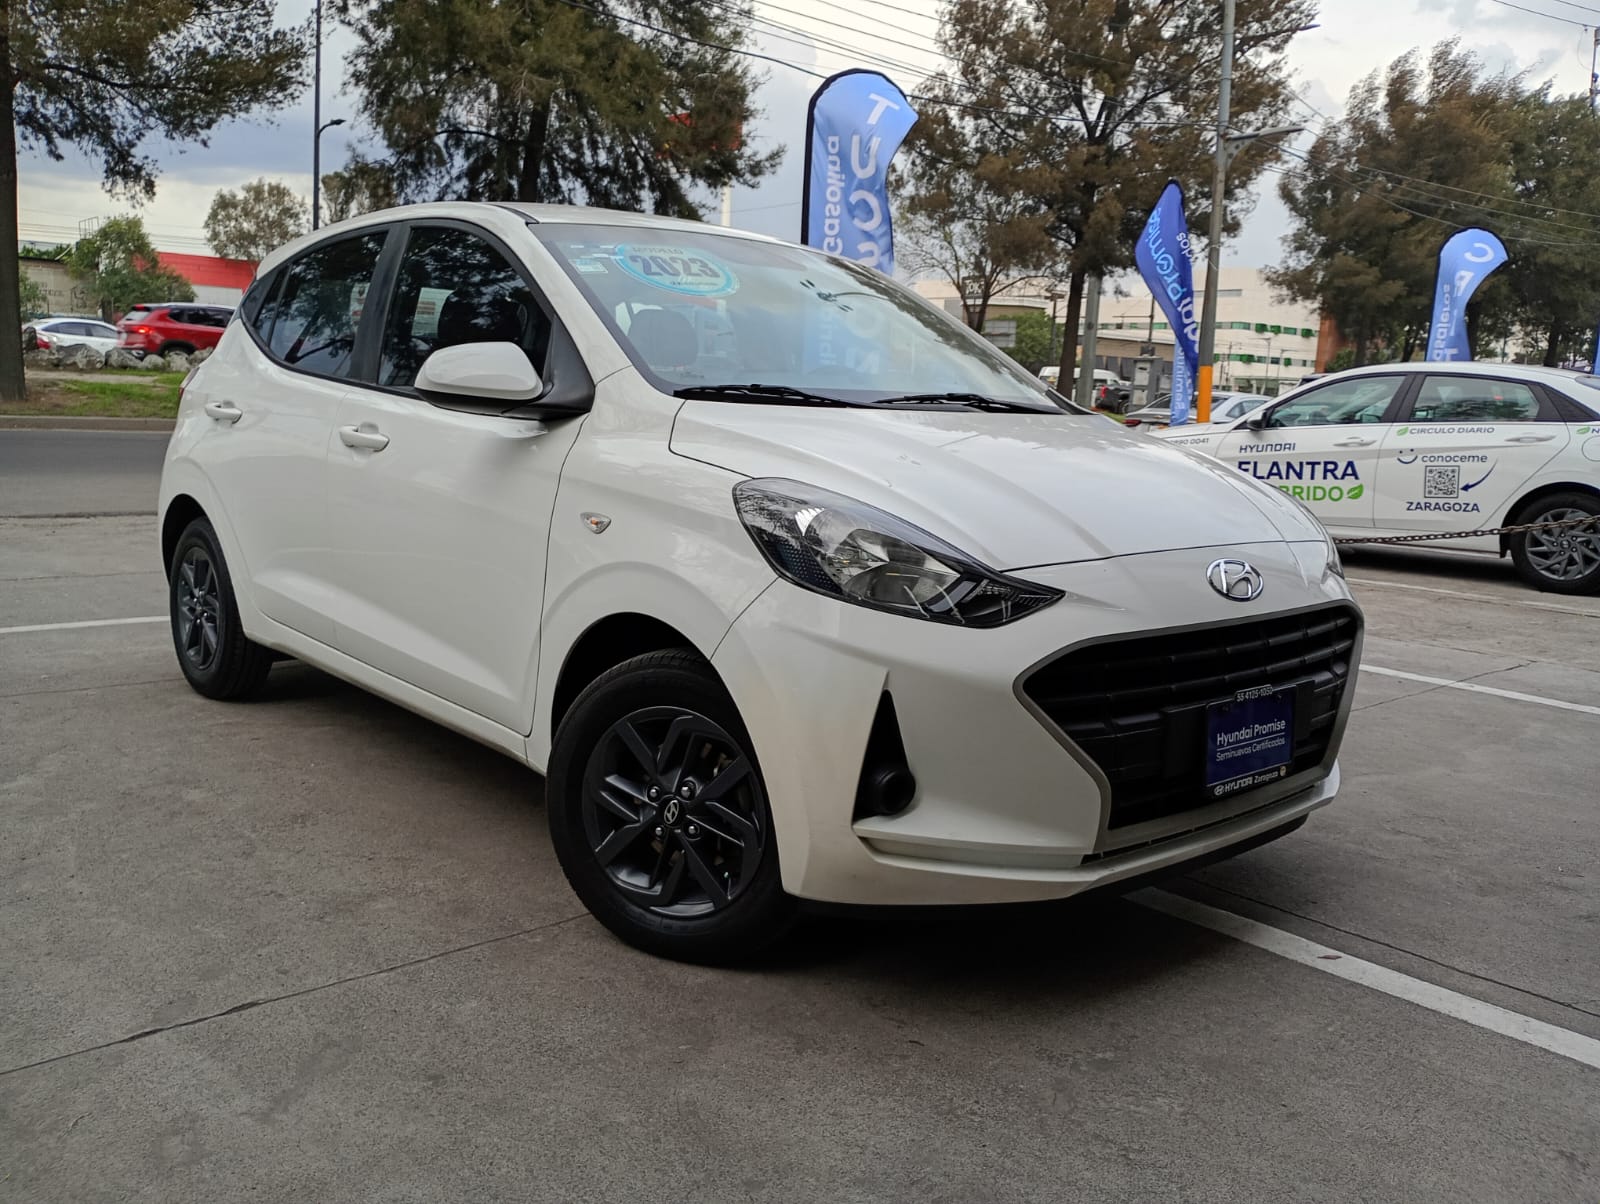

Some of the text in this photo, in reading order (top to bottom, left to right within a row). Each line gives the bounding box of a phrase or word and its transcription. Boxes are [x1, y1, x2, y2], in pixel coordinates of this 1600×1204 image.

[629, 255, 721, 278] 2023
[1239, 443, 1296, 453] HYUNDAI
[1421, 454, 1488, 464] conoceme
[1405, 501, 1481, 513] ZARAGOZA
[1216, 719, 1286, 746] Hyundai Promise
[1216, 736, 1286, 762] Seminuevos Certificados
[1225, 777, 1253, 792] HYUNDAI
